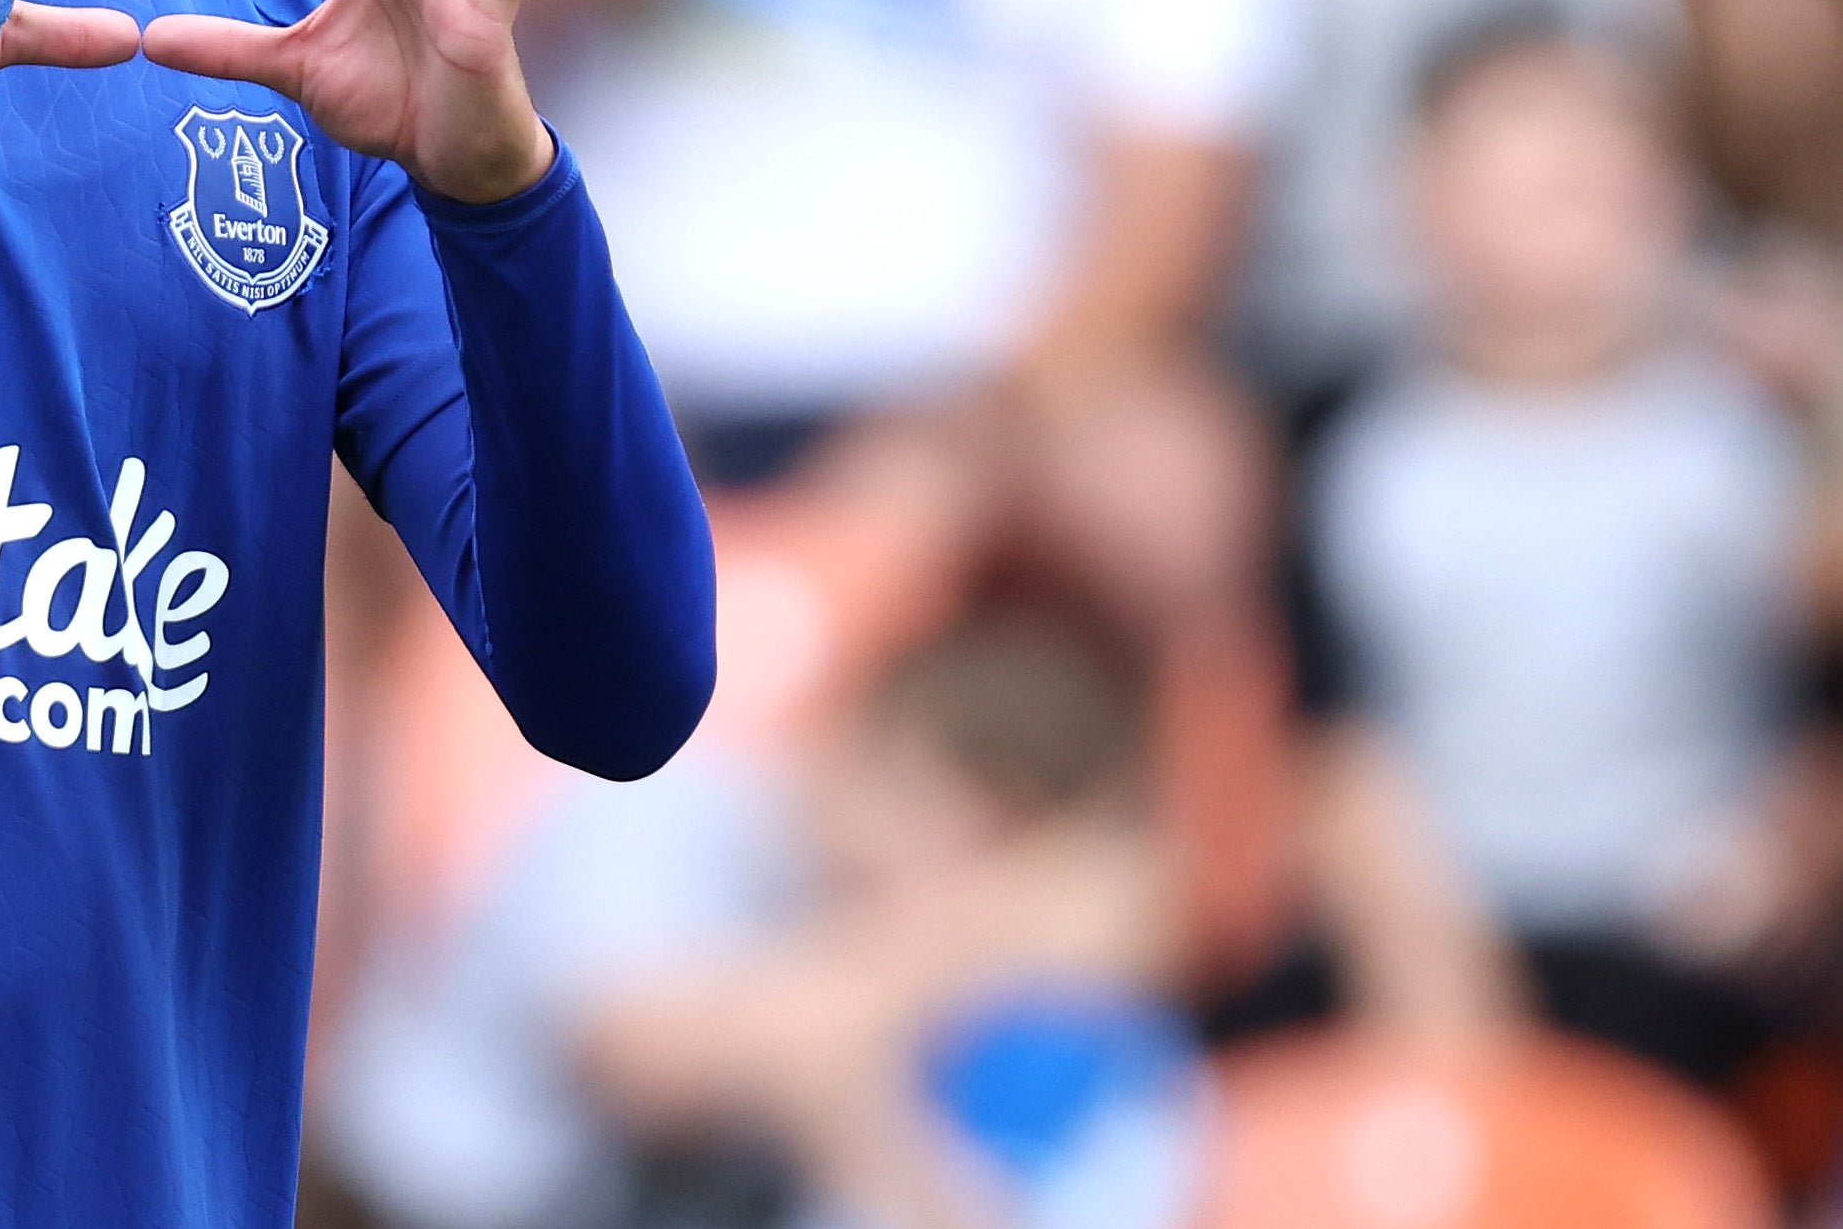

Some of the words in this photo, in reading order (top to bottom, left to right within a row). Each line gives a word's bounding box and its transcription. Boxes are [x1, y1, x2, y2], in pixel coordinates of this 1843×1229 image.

[213, 213, 287, 246] Everton
[187, 236, 204, 265] NIL
[205, 262, 240, 295] SATIS
[242, 284, 265, 299] NISI
[267, 250, 310, 295] OPTIMUM
[242, 247, 266, 264] 1878
